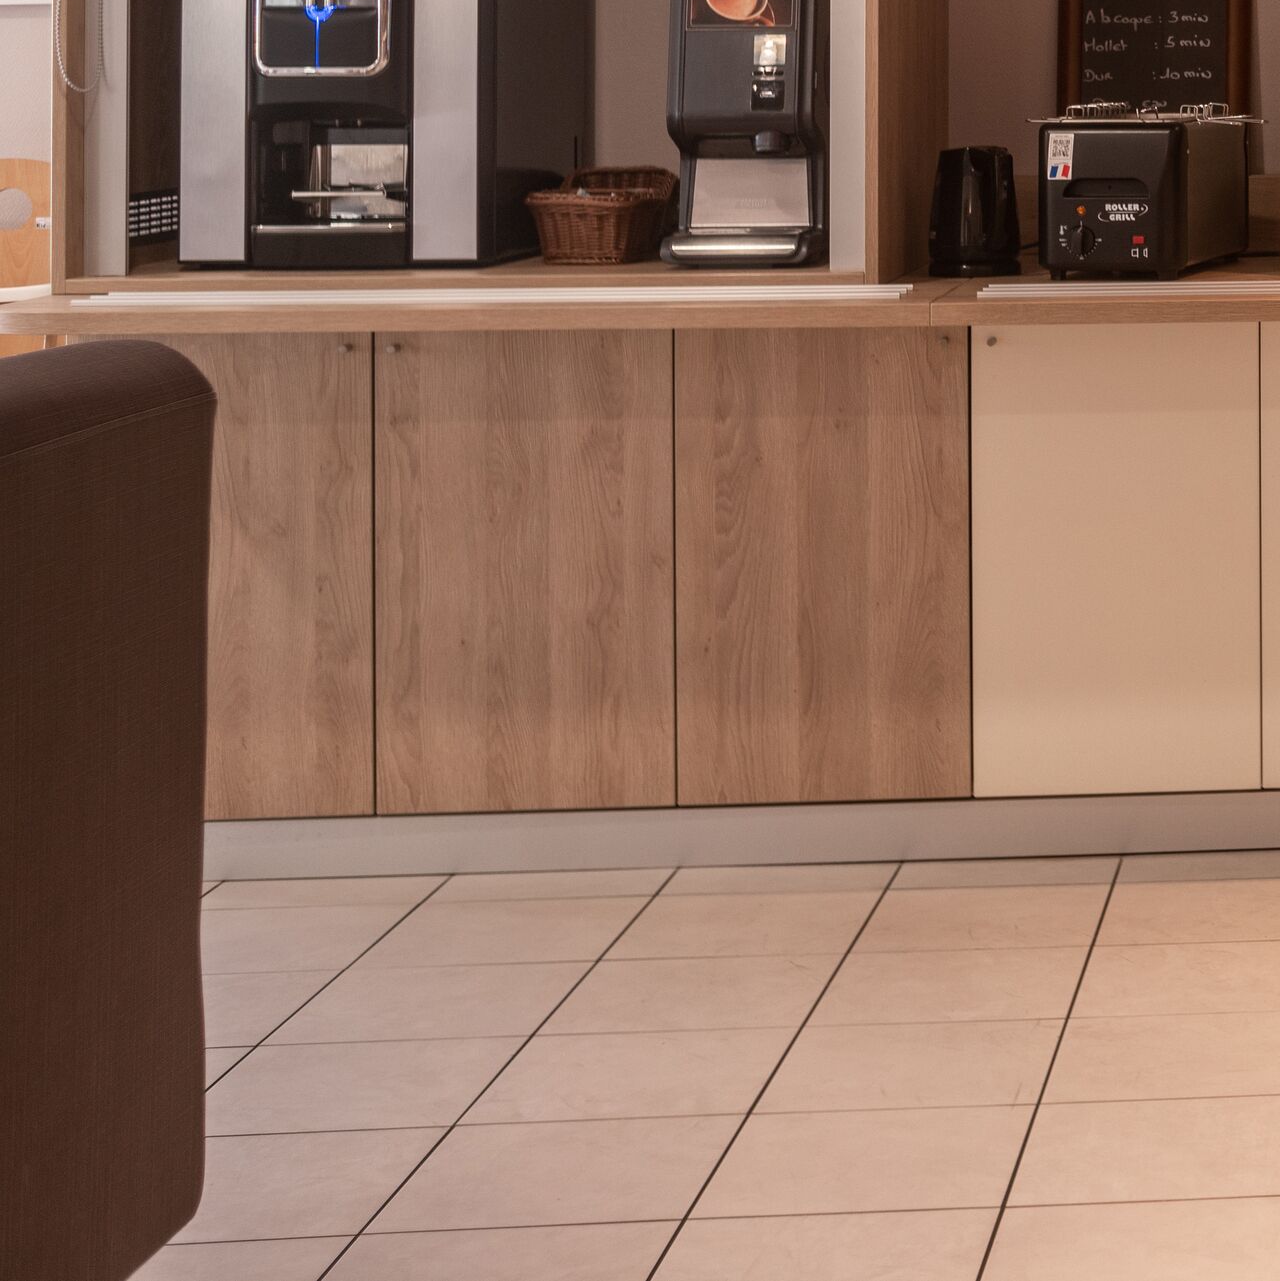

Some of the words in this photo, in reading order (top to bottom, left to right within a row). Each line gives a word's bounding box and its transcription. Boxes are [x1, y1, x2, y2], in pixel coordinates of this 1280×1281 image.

[1085, 10, 1096, 25] A
[1112, 14, 1154, 32] coque
[1167, 10, 1179, 24] 3
[1181, 12, 1209, 24] min
[1164, 36, 1176, 48] 5
[1179, 34, 1211, 48] min
[1083, 69, 1113, 82] Dur
[1160, 67, 1180, 80] 10
[1184, 67, 1212, 80] min
[1105, 204, 1140, 212] ROLLER
[1109, 213, 1135, 221] GRILL
